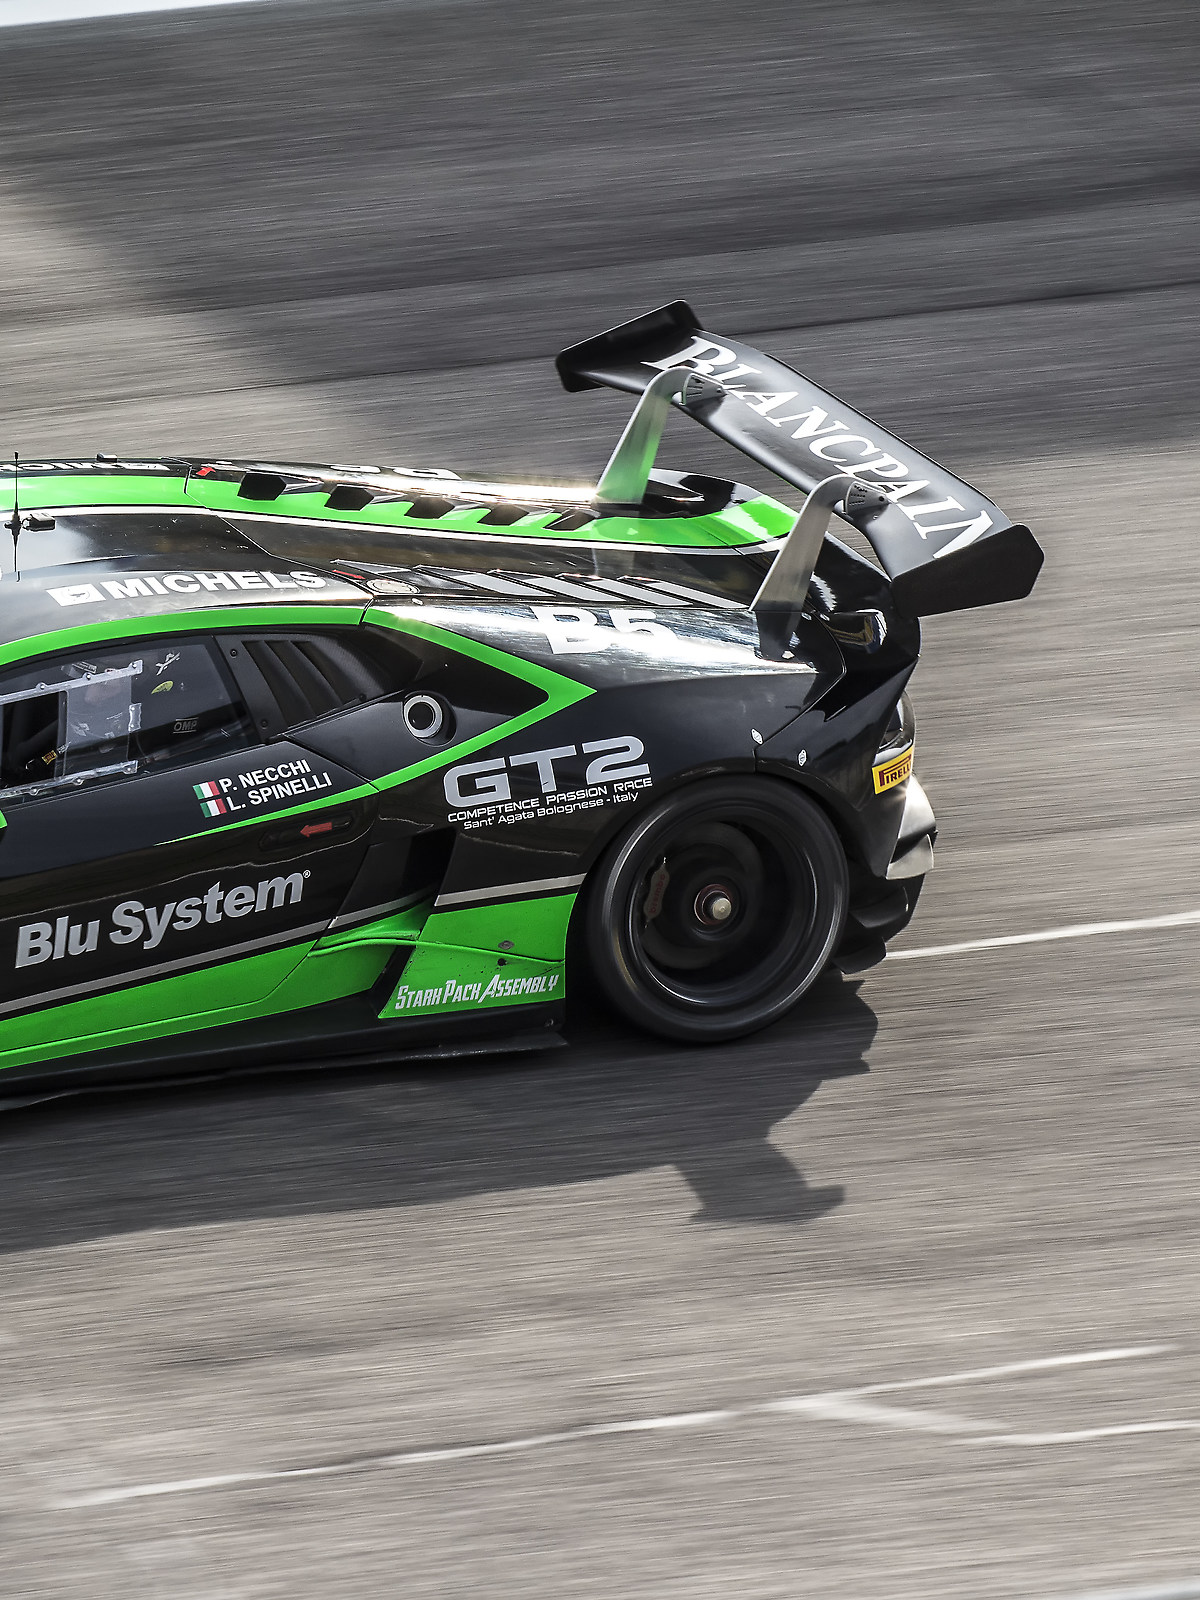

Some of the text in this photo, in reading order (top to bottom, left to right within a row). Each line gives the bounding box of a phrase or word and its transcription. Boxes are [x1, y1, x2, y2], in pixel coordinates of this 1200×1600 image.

[100, 571, 326, 600] MICHELS
[529, 606, 680, 655] B5
[174, 719, 198, 732] OMP
[219, 759, 312, 793] P. NECCHI
[443, 735, 650, 808] GT2
[879, 754, 912, 787] PIRELL
[226, 772, 332, 811] L. SPINELLI
[448, 777, 653, 823] COMPETENCE PASSION RACE
[498, 811, 535, 826] Agata
[537, 799, 604, 817] Bolognese
[613, 791, 639, 805] Italy
[15, 916, 100, 969] Blu
[442, 980, 482, 1004] PACK
[478, 975, 560, 1003] ASSEMBLY
